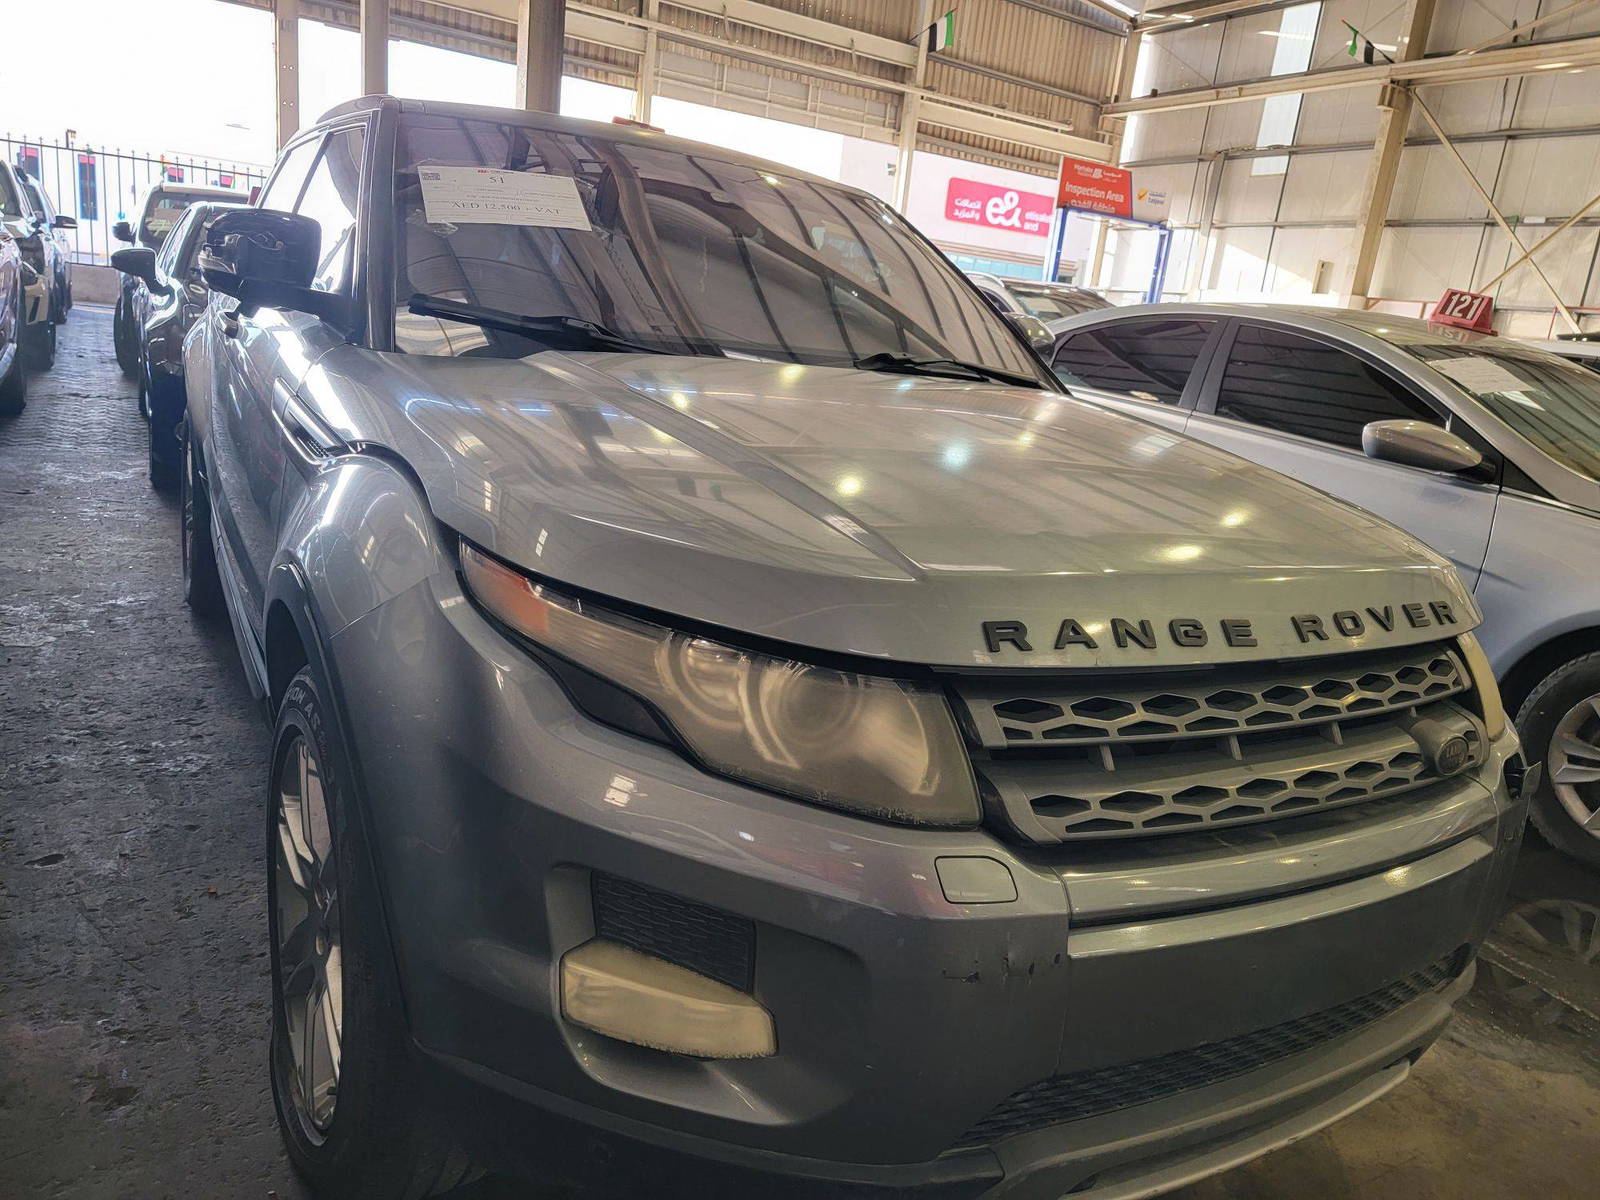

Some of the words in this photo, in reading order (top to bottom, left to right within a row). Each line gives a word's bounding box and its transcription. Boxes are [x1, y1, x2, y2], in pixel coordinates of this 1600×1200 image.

[1065, 181, 1105, 199] Inspection
[1106, 190, 1125, 203] Area
[451, 201, 480, 209] AED
[535, 207, 561, 215] VAT
[1023, 221, 1040, 232] and
[1445, 293, 1486, 320] 121
[982, 617, 1258, 653] RANGE
[1291, 600, 1459, 643] ROVER
